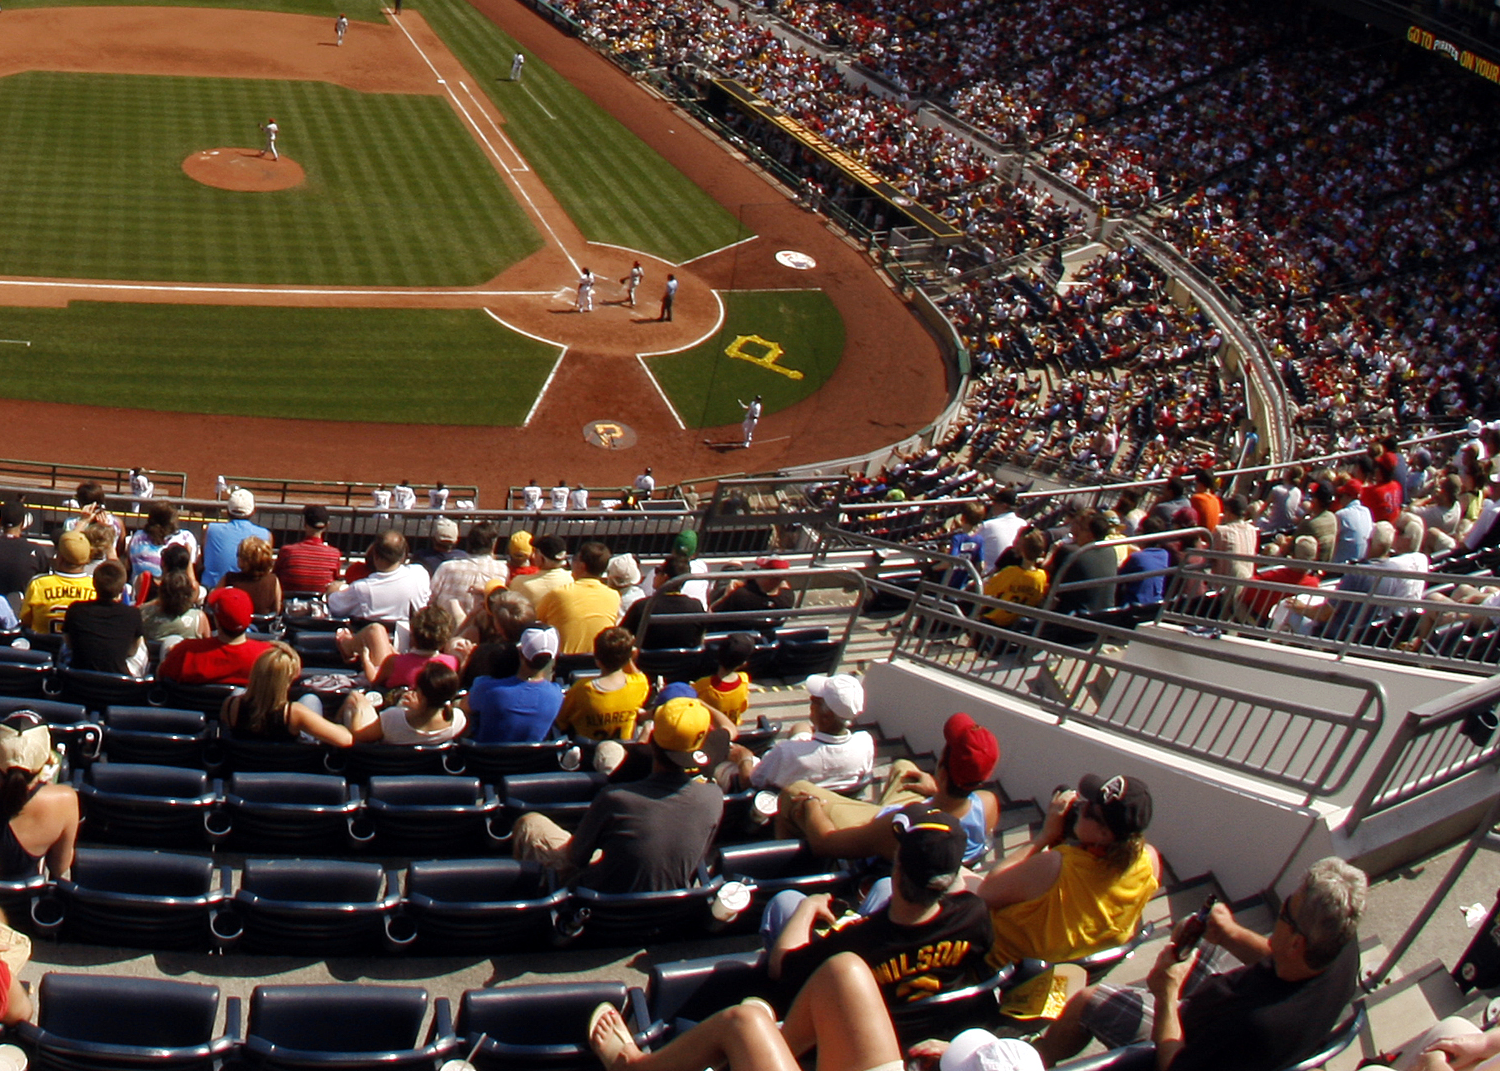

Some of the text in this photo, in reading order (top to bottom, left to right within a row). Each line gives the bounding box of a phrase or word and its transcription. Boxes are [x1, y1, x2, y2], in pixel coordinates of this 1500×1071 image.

[1407, 26, 1500, 85] GO TO PIRATES ON YOUR
[874, 940, 971, 985] WILSON
